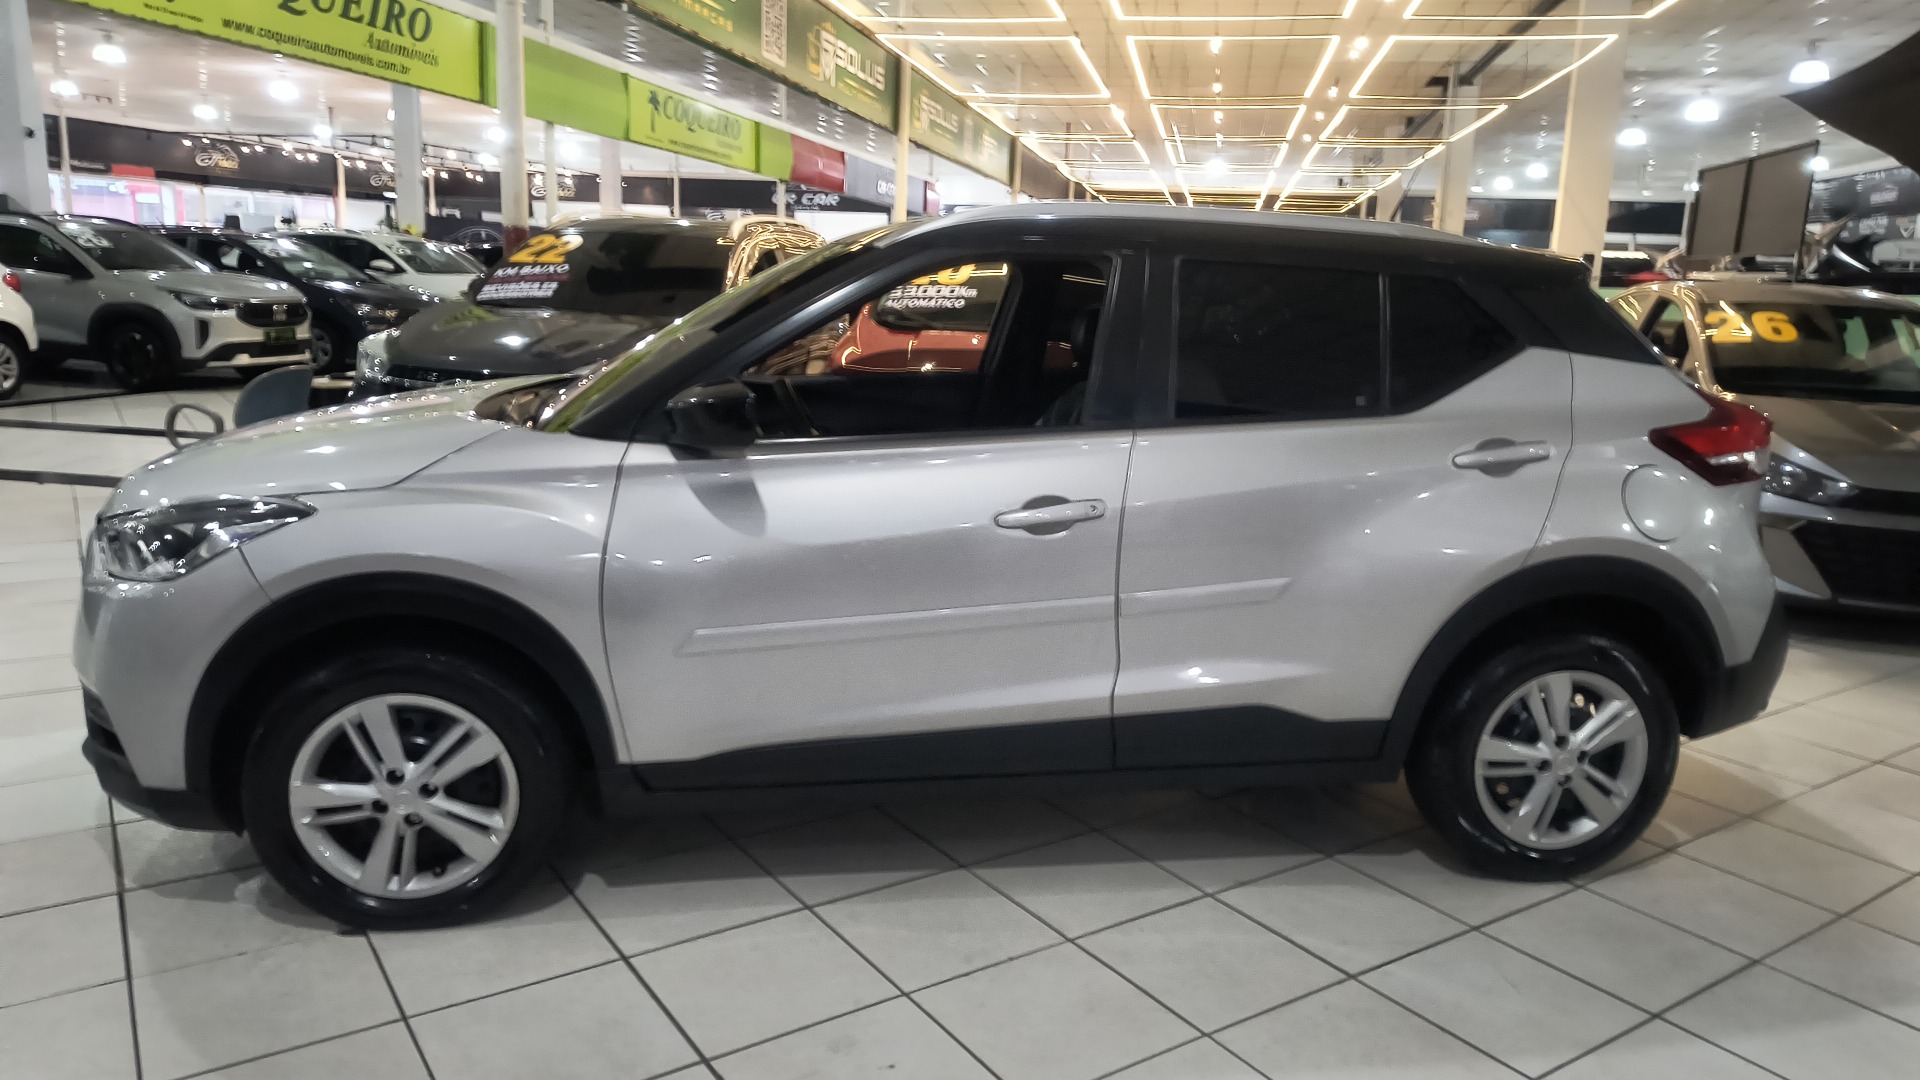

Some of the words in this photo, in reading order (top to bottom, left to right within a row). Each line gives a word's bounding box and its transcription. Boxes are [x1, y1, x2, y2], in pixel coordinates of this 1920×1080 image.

[277, 0, 432, 43] EIRO
[508, 233, 584, 264] 22
[519, 263, 570, 276] BAIXO
[884, 296, 966, 310] AUTOMÁTICO
[1704, 310, 1799, 344] 26
